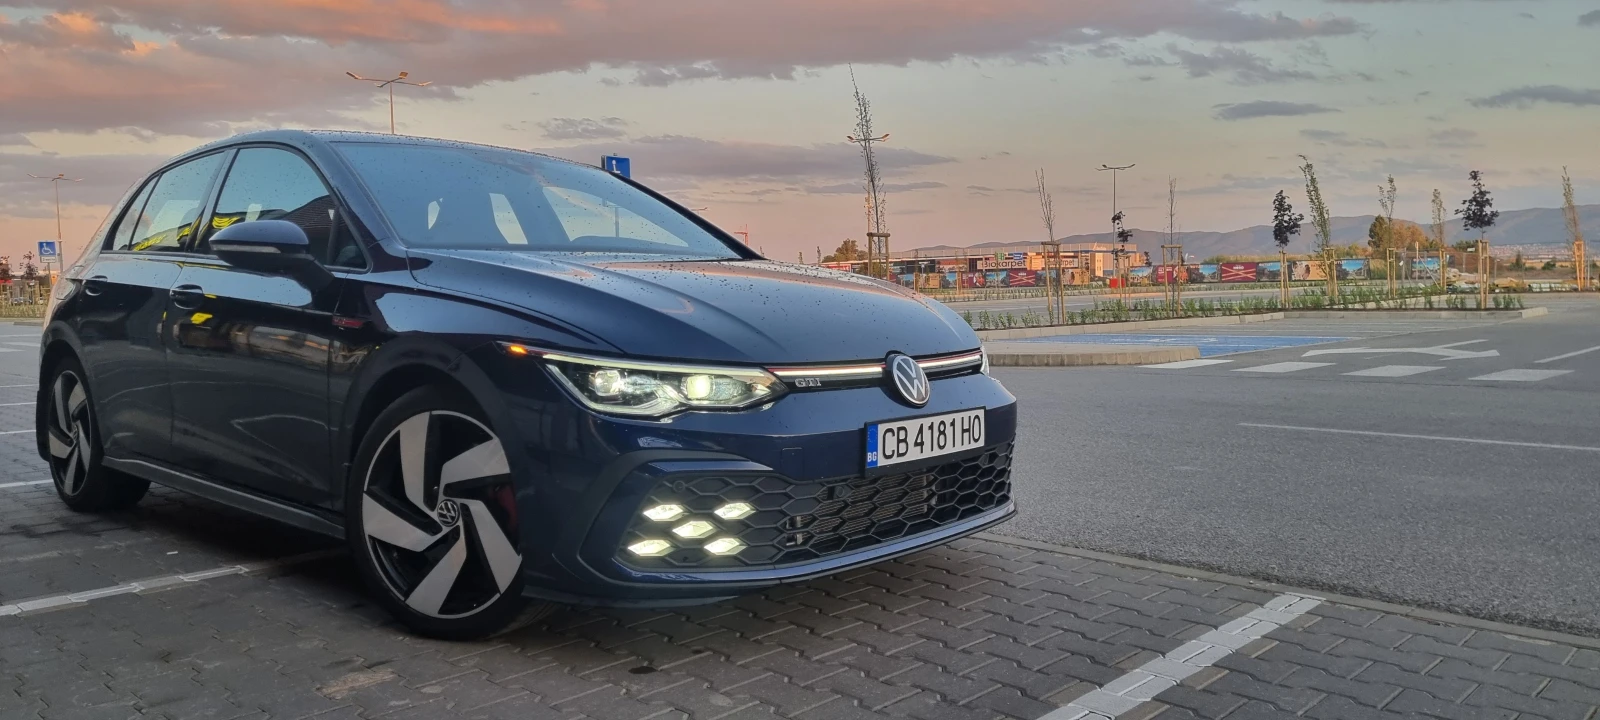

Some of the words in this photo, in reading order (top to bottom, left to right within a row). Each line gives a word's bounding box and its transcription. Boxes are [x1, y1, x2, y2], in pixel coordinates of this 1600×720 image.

[982, 260, 1026, 269] Biokarpet
[794, 377, 822, 387] GTI
[882, 426, 909, 459] CB
[914, 418, 956, 454] 4181
[961, 414, 981, 446] HO
[867, 451, 878, 462] BG
